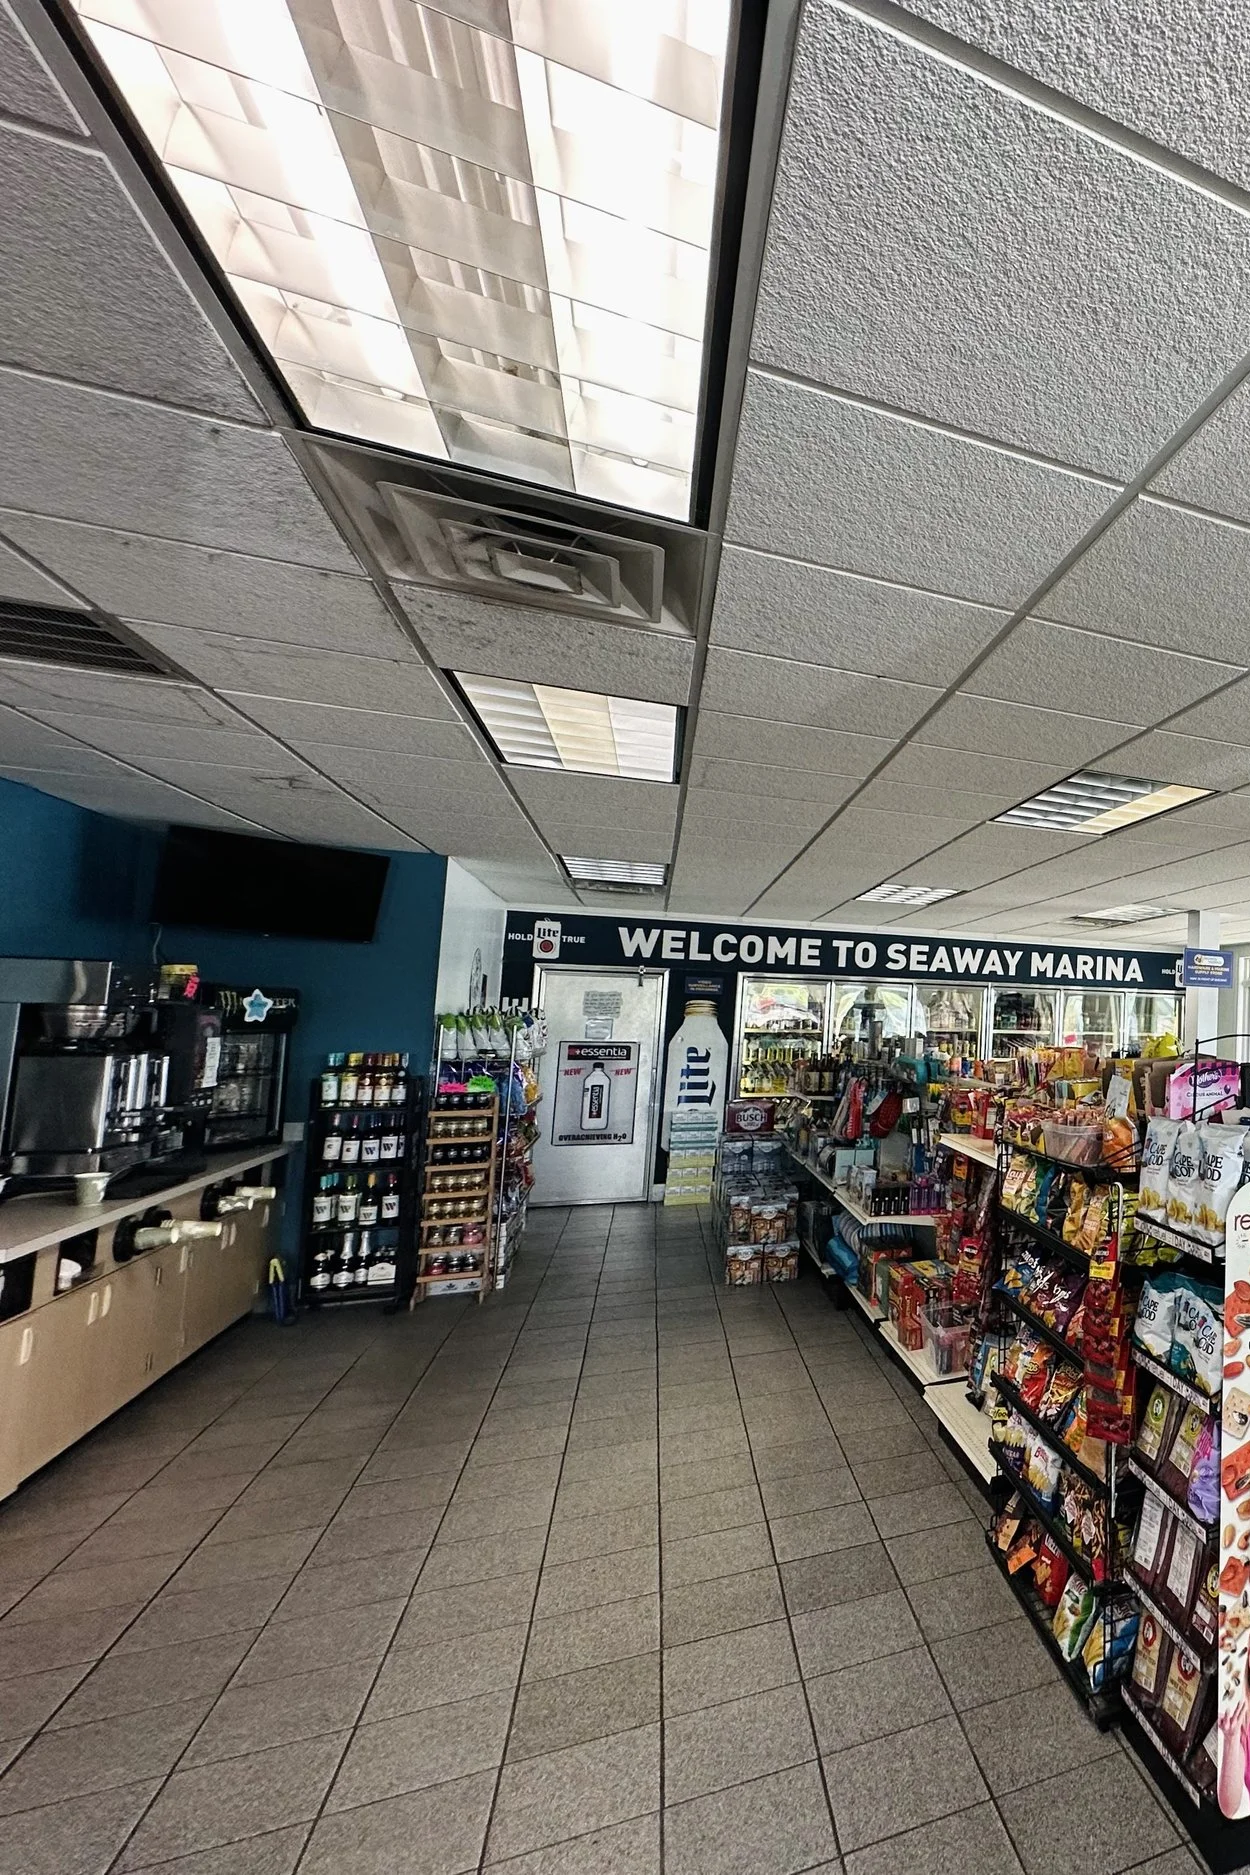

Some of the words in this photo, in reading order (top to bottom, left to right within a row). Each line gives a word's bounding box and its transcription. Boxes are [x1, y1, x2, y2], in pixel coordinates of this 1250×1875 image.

[508, 932, 533, 941] HOLD
[537, 927, 559, 939] Lite
[562, 935, 586, 944] TRUE
[618, 926, 822, 967] WELCOME
[832, 939, 876, 969] TO
[886, 943, 1022, 978] SEAWAY
[1030, 952, 1144, 983] MARINA
[563, 1067, 583, 1076] NEW
[614, 1067, 633, 1076] NEW
[677, 1046, 717, 1107] Lite
[736, 1113, 767, 1123] BUSCH
[1174, 1152, 1194, 1167] CAPE
[1206, 1154, 1224, 1169] APE
[1174, 1165, 1195, 1178] COD
[1206, 1169, 1222, 1182] OD
[1142, 1296, 1159, 1313] CAPE
